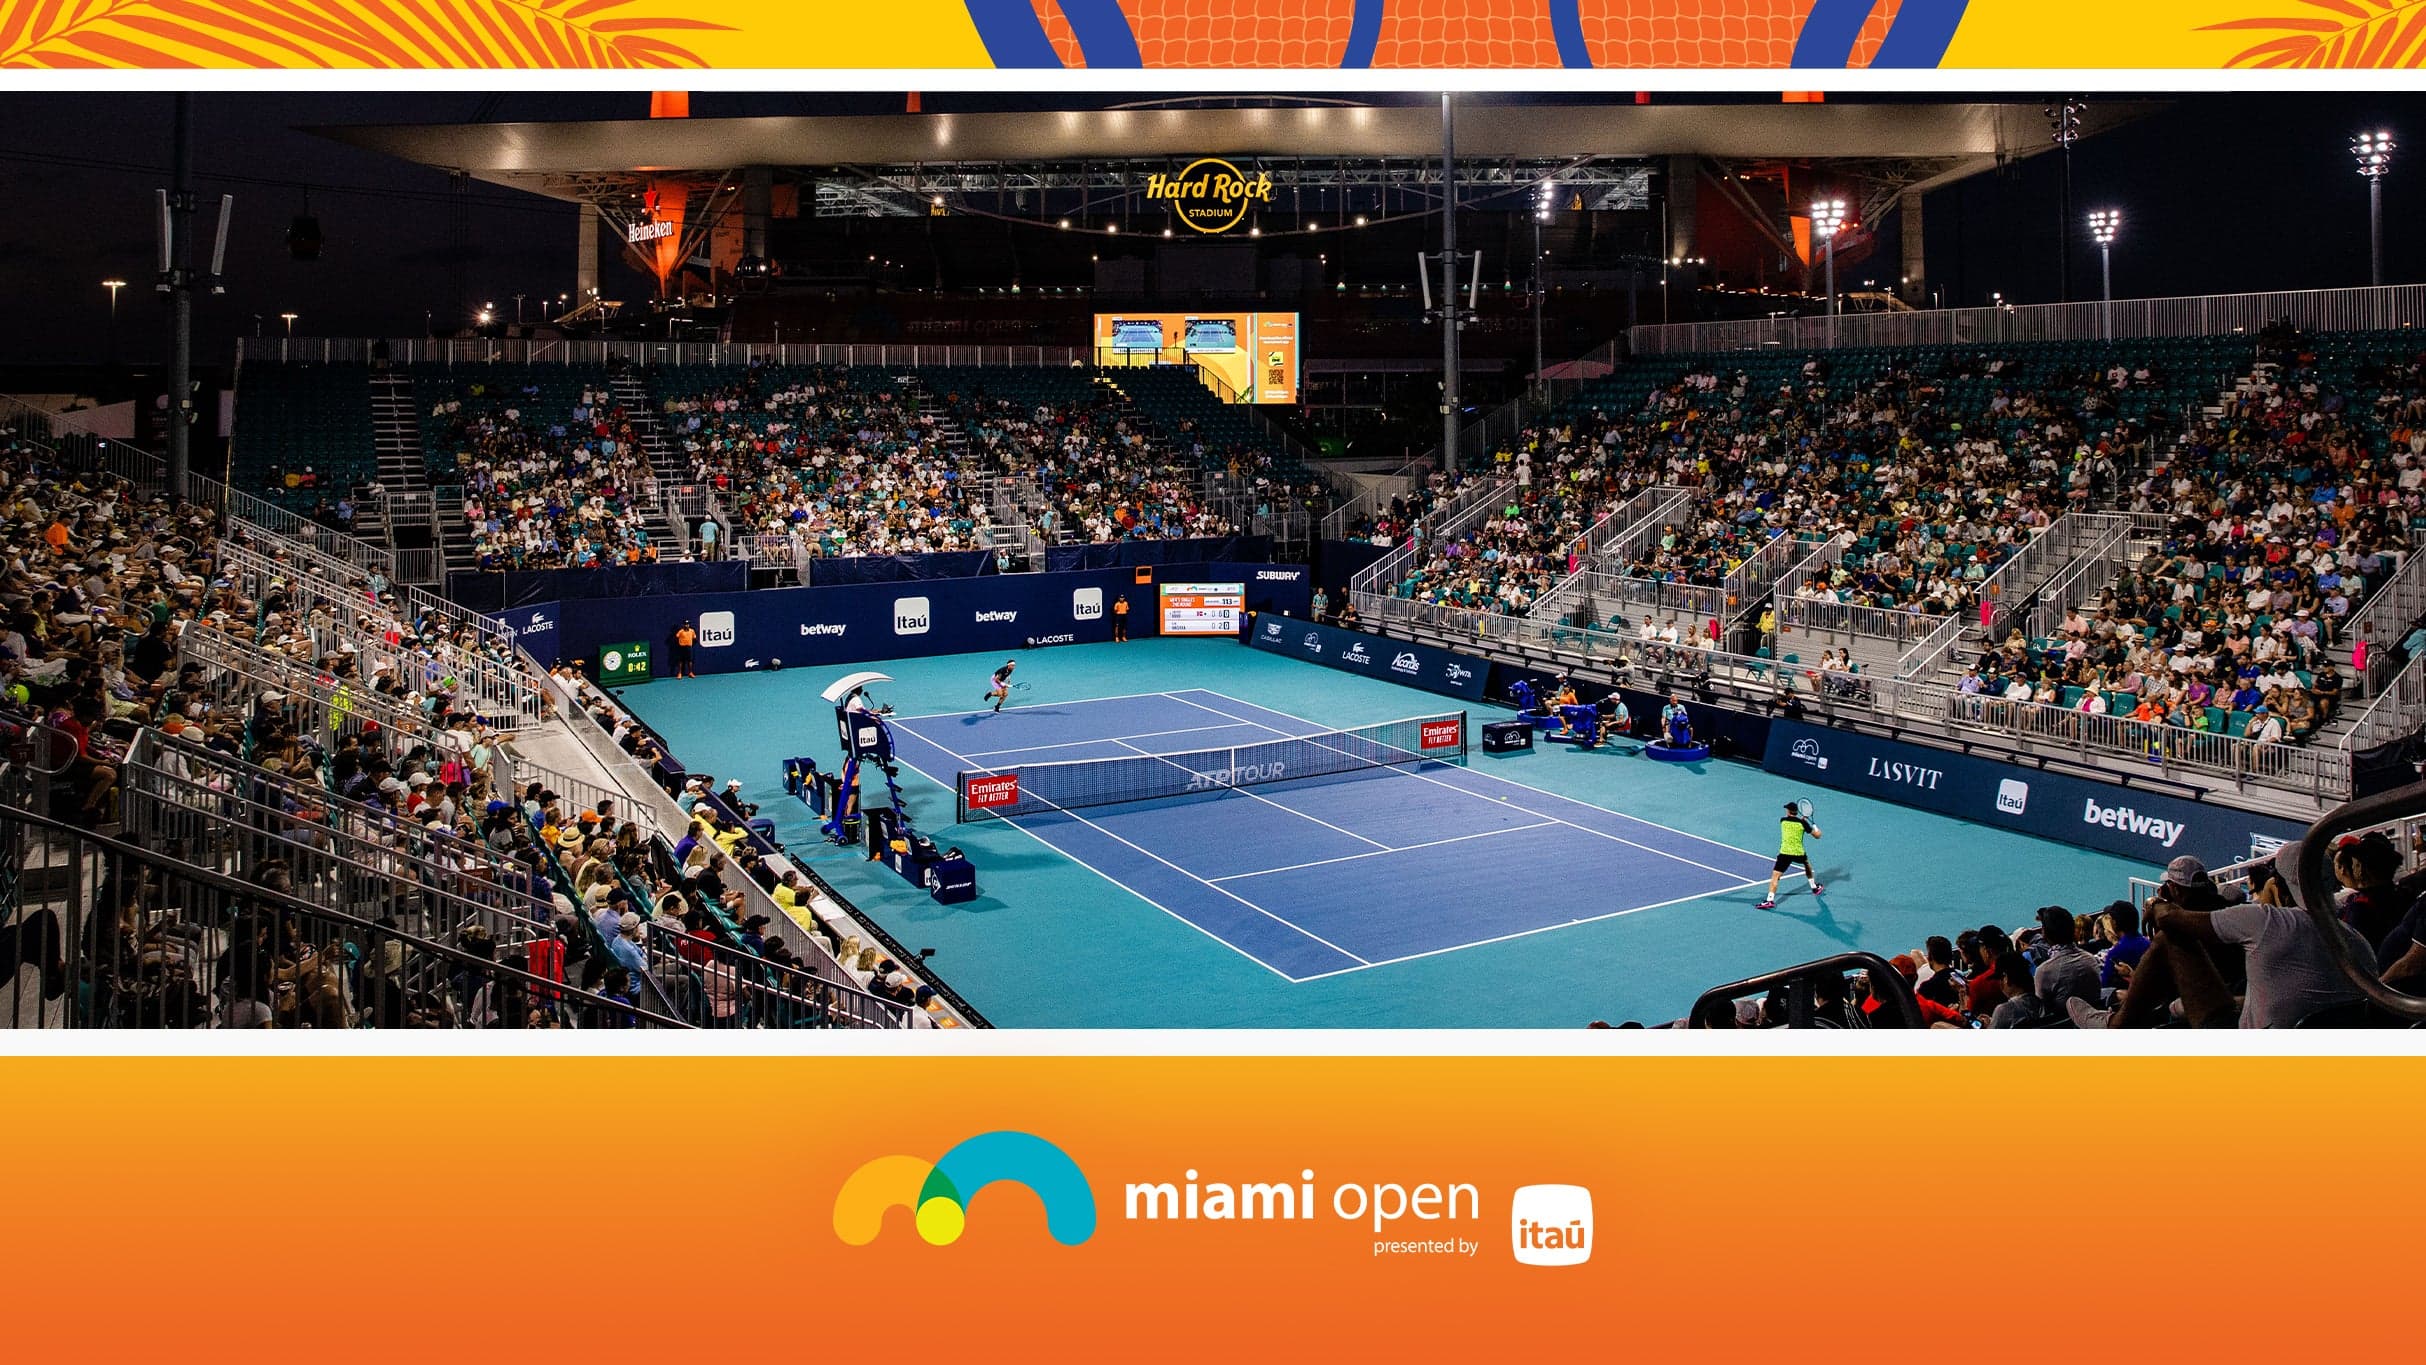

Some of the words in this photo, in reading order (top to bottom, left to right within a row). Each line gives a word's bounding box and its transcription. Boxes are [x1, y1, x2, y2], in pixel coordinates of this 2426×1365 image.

[1146, 173, 1210, 199] Hard
[1212, 172, 1272, 204] Rock
[1188, 209, 1233, 218] STADIUM
[628, 220, 673, 242] Heineken
[1256, 571, 1300, 581] SUBWAY
[1076, 602, 1101, 615] Itaú
[897, 614, 927, 629] Itaú
[975, 611, 1017, 622] betway
[523, 620, 553, 635] LACOSTE
[800, 624, 846, 636] betway
[702, 628, 732, 642] Itaú
[1036, 634, 1074, 644] LACOSTE
[1342, 651, 1371, 665] LACOSTE
[628, 661, 646, 673] 0:42
[1424, 724, 1458, 737] Emirates
[1186, 769, 1232, 791] ATP
[1234, 762, 1285, 784] TOUR
[1868, 757, 1943, 790] LASVIT
[971, 780, 1017, 795] Emirates
[989, 792, 1009, 802] BETTER
[1999, 794, 2023, 810] Itaú
[2084, 798, 2185, 848] betway
